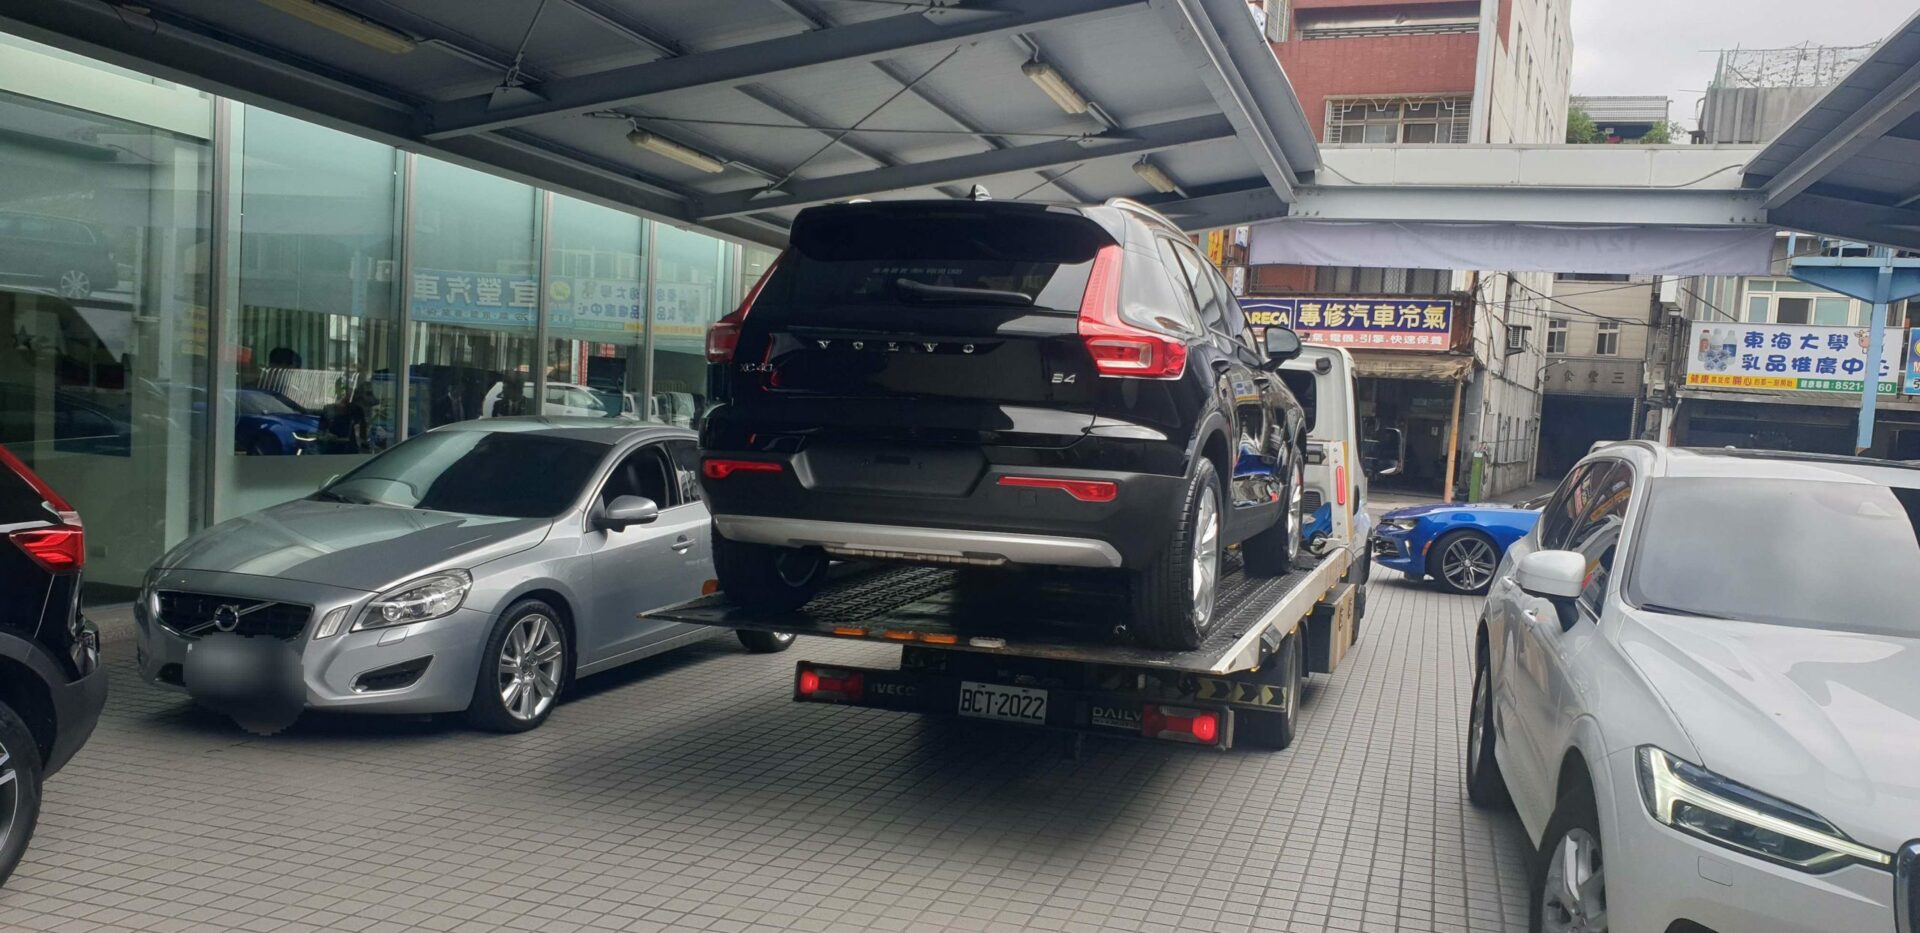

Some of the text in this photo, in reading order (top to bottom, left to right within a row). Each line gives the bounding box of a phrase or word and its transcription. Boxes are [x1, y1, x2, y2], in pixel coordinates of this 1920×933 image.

[1298, 302, 1447, 330] 專修汽車冷氣
[816, 339, 976, 354] VOLVO
[1743, 331, 1849, 352] 東海大學
[1051, 373, 1077, 385] B4
[872, 682, 917, 697] IVECO
